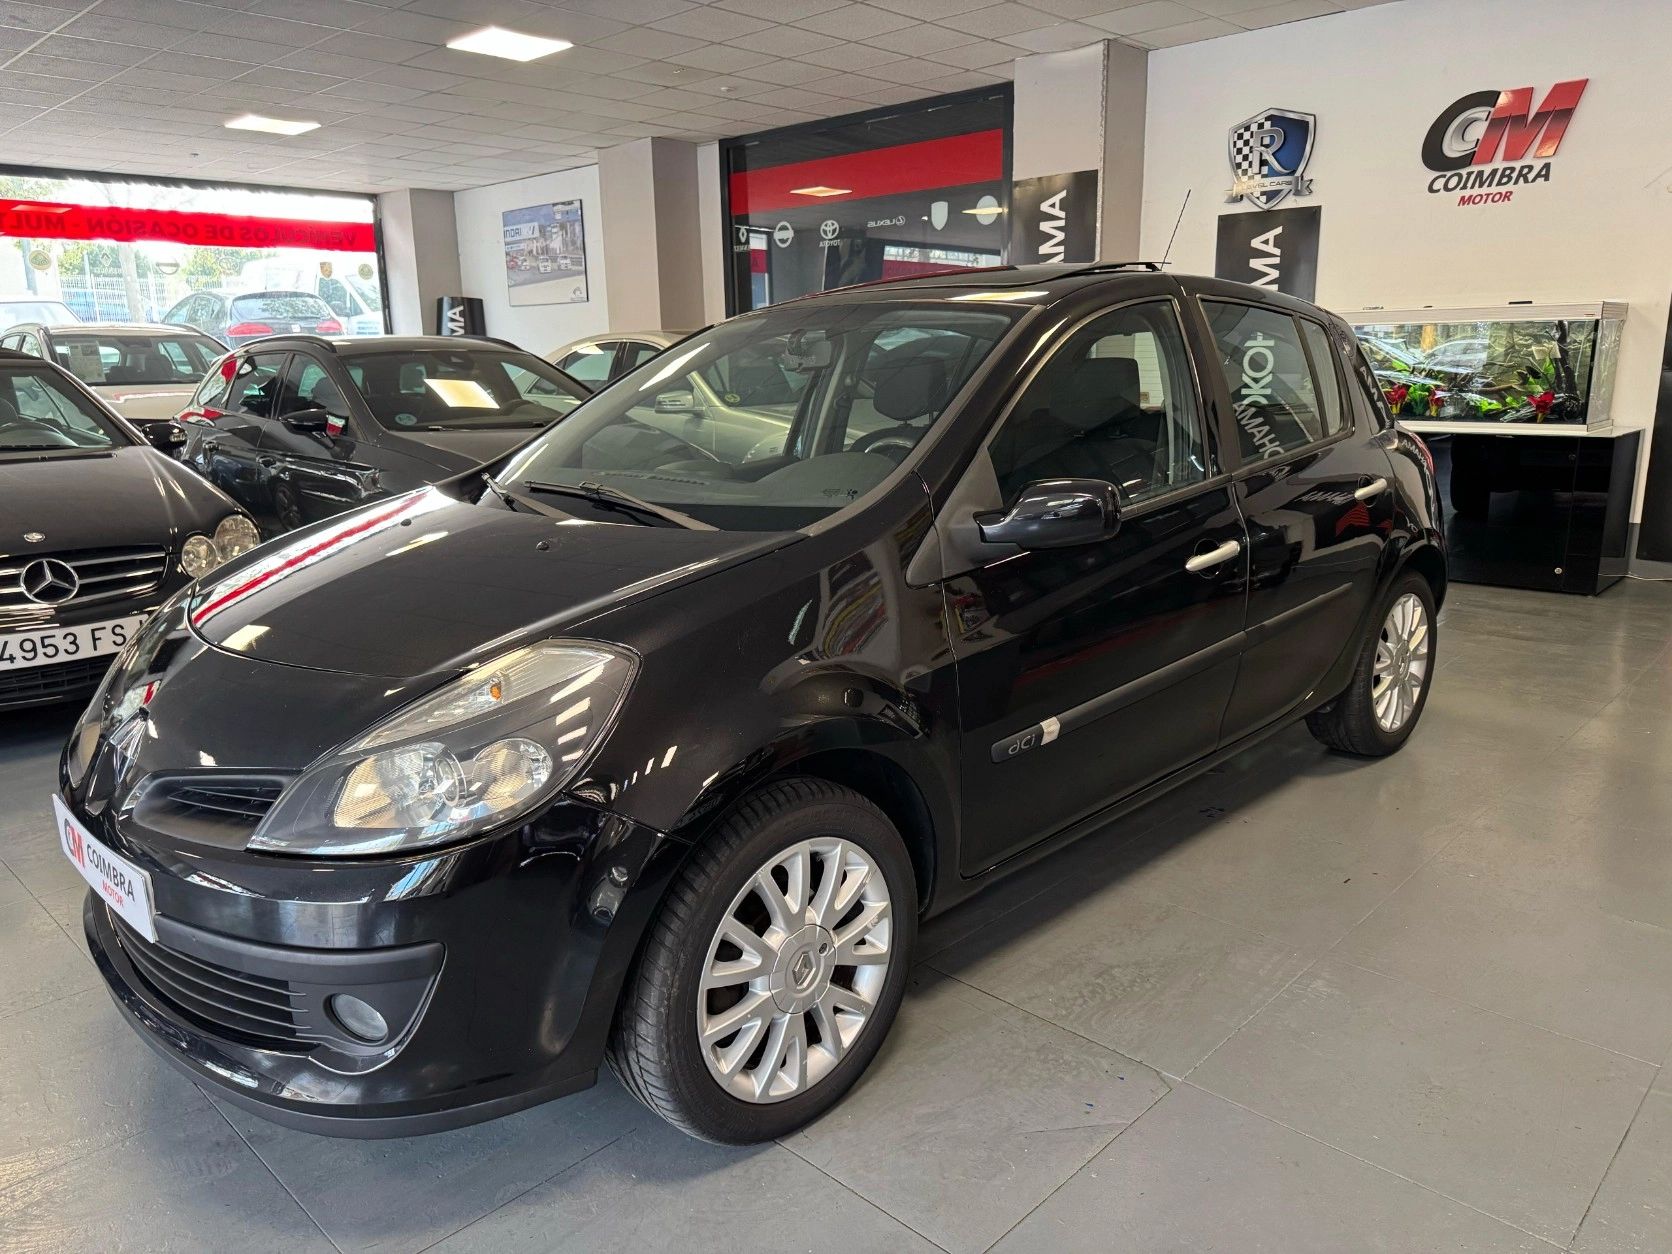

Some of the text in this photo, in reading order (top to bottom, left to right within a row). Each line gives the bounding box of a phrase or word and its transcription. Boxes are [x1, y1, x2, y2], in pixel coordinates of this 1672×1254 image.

[1427, 161, 1552, 194] COIMBRA
[1457, 190, 1514, 207] MOTOR
[0, 619, 147, 664] 4953 FS
[86, 843, 135, 903] COIMBRA
[102, 879, 124, 909] MOTOR
